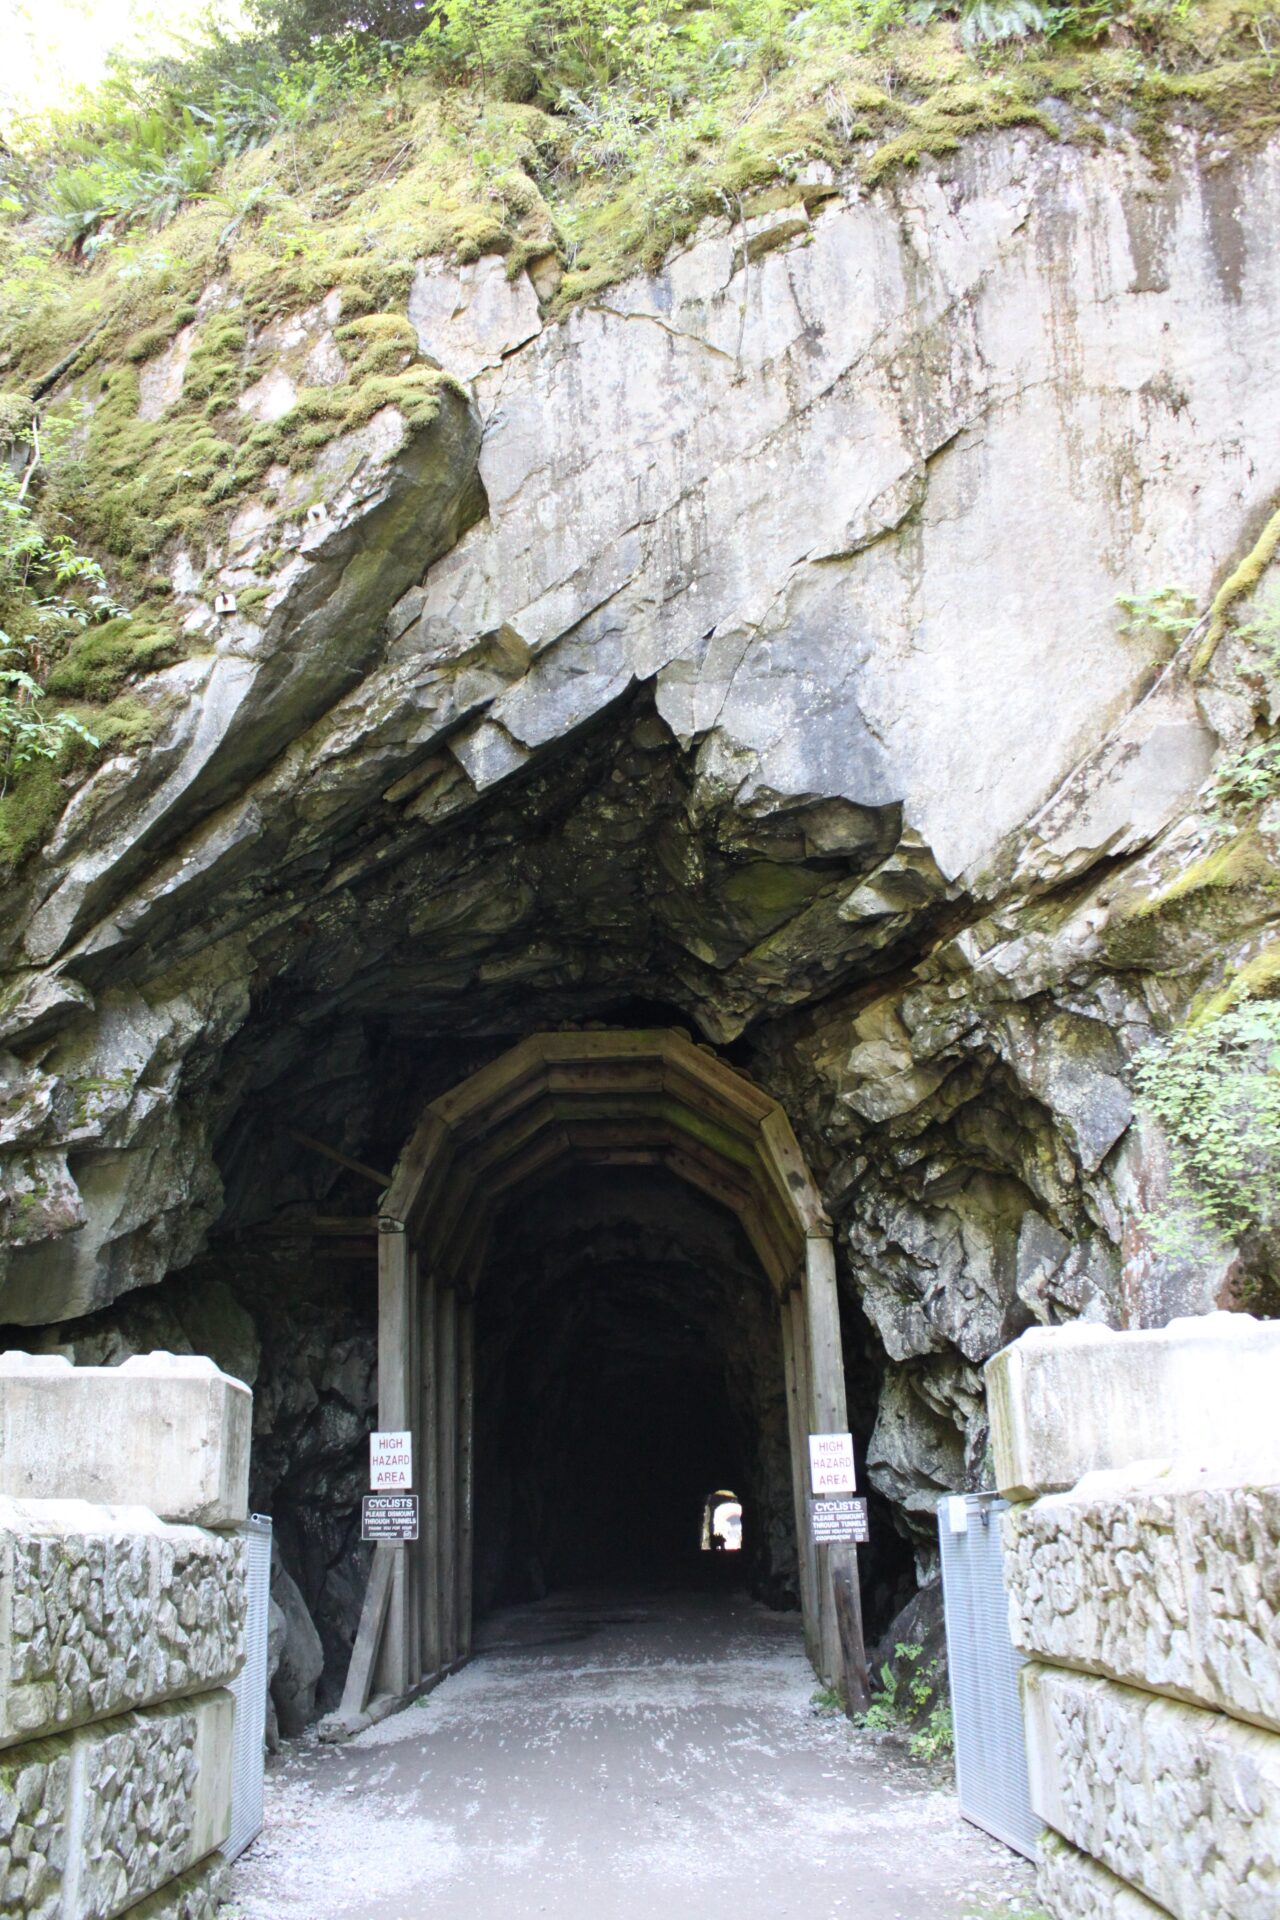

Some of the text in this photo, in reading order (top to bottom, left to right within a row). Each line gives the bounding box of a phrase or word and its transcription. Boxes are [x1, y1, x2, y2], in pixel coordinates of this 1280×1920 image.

[379, 1438, 403, 1449] HIGH
[819, 1441, 843, 1451] HIGH
[372, 1455, 410, 1466] HAZARD
[813, 1457, 851, 1469] HAZARD
[377, 1471, 406, 1482] AREA
[819, 1474, 848, 1485] AREA
[368, 1499, 413, 1508] CYCLISTS
[815, 1501, 861, 1511] CYCLISTS
